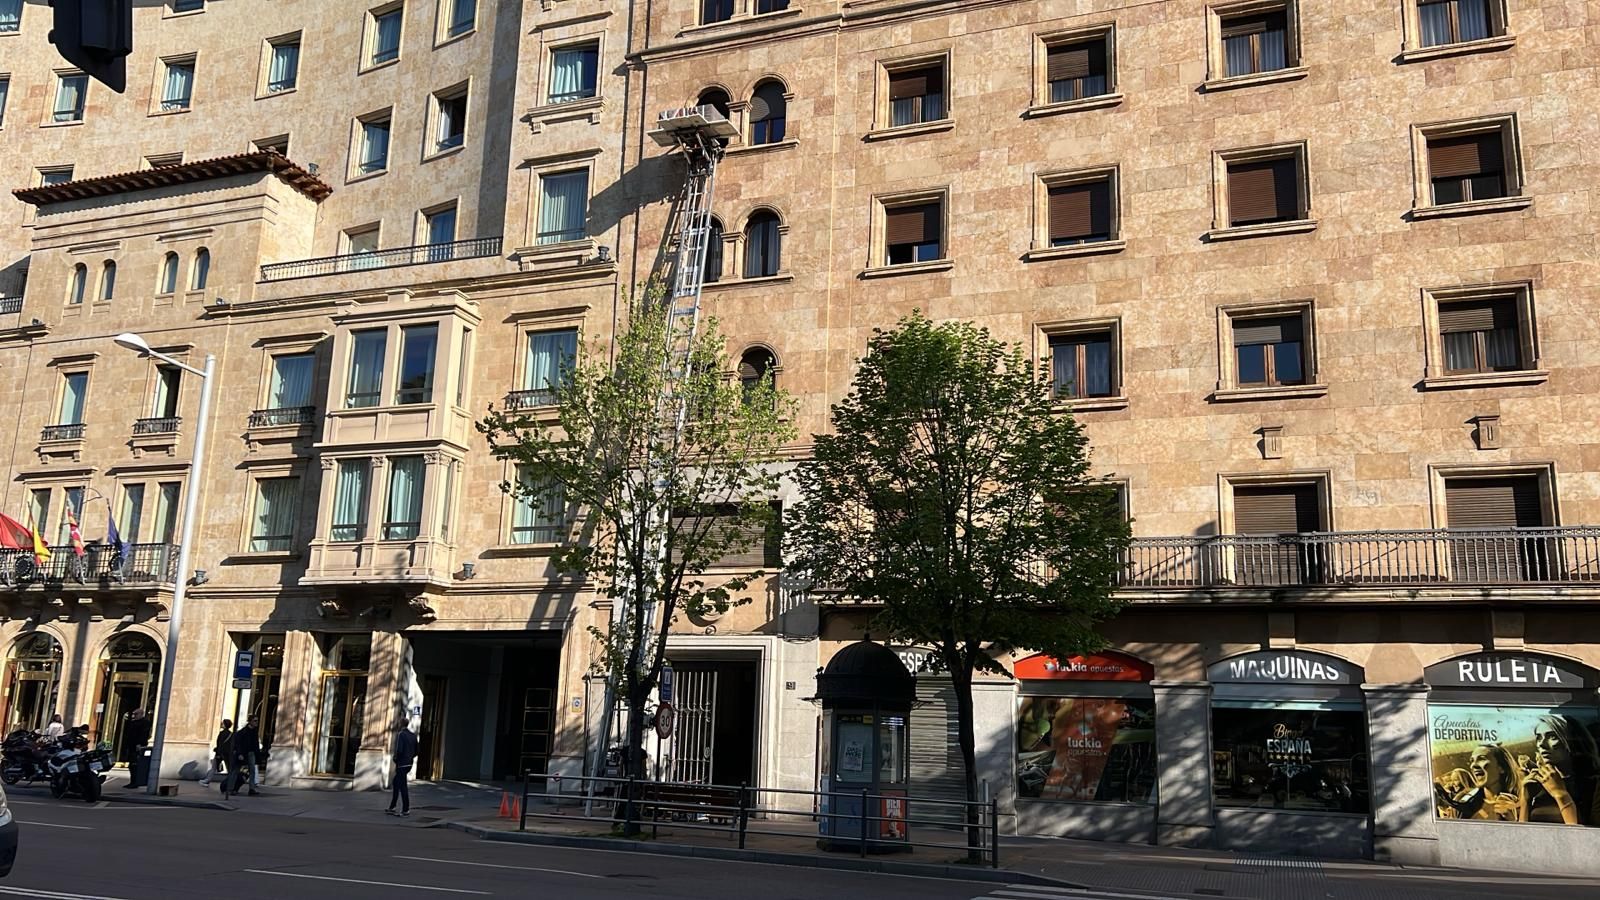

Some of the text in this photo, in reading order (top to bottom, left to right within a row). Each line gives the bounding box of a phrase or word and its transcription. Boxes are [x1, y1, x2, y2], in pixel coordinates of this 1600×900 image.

[1230, 656, 1340, 681] MAQUINAS
[1458, 657, 1562, 683] RULETA
[661, 715, 671, 727] 30
[1434, 714, 1481, 731] Apuestas
[1067, 737, 1102, 748] luckia
[1434, 728, 1498, 741] DEPORTIVAS
[1267, 737, 1312, 754] ESPAÑA
